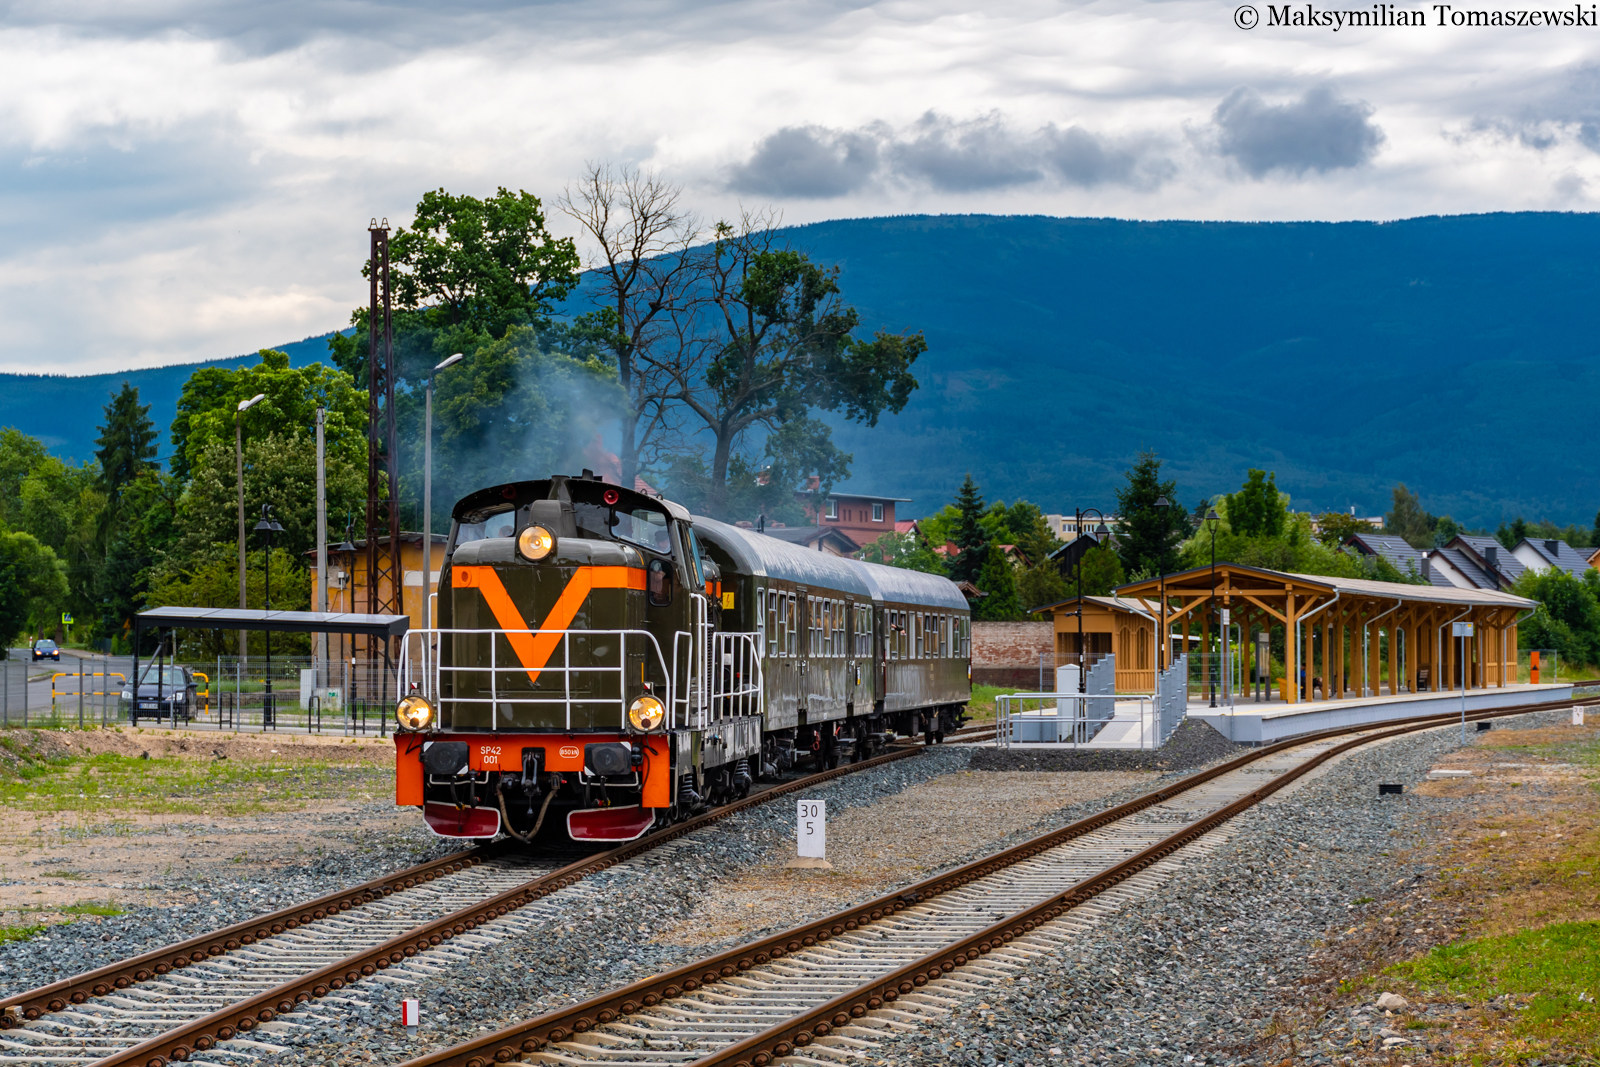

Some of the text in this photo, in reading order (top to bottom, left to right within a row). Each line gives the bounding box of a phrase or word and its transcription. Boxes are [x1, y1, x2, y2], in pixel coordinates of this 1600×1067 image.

[480, 746, 501, 755] SP42
[483, 755, 498, 764] 001
[801, 804, 818, 818] 30
[806, 821, 814, 835] 5
